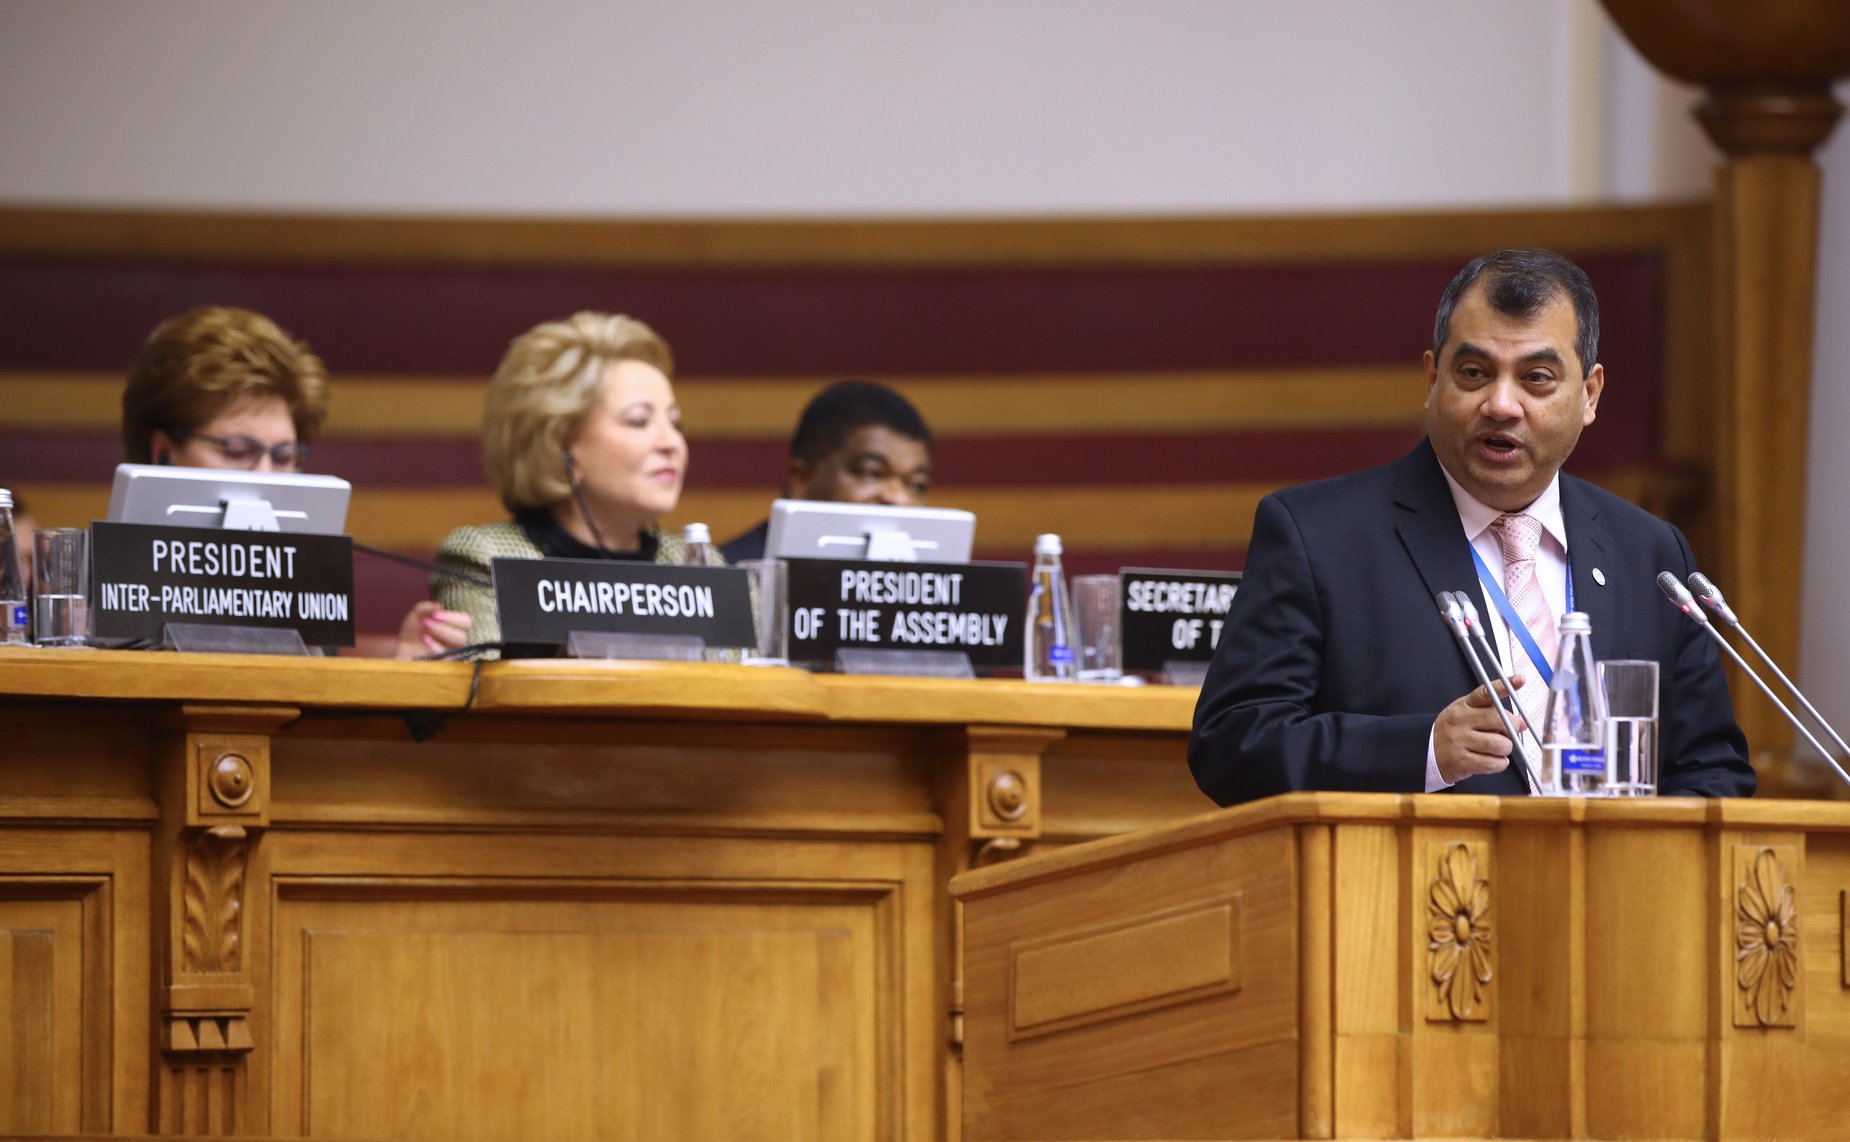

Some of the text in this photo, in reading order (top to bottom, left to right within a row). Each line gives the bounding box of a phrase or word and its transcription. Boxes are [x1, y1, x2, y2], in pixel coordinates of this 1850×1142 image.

[153, 540, 297, 579] PRESIDENT
[101, 582, 348, 621] INTER-PARLIAMENTARY UNION
[537, 579, 715, 618] CHAIRPERSON
[840, 569, 963, 605] PRESIDENT
[794, 607, 1008, 646] OF THE ASSEMBLY
[1171, 618, 1204, 650] OF
